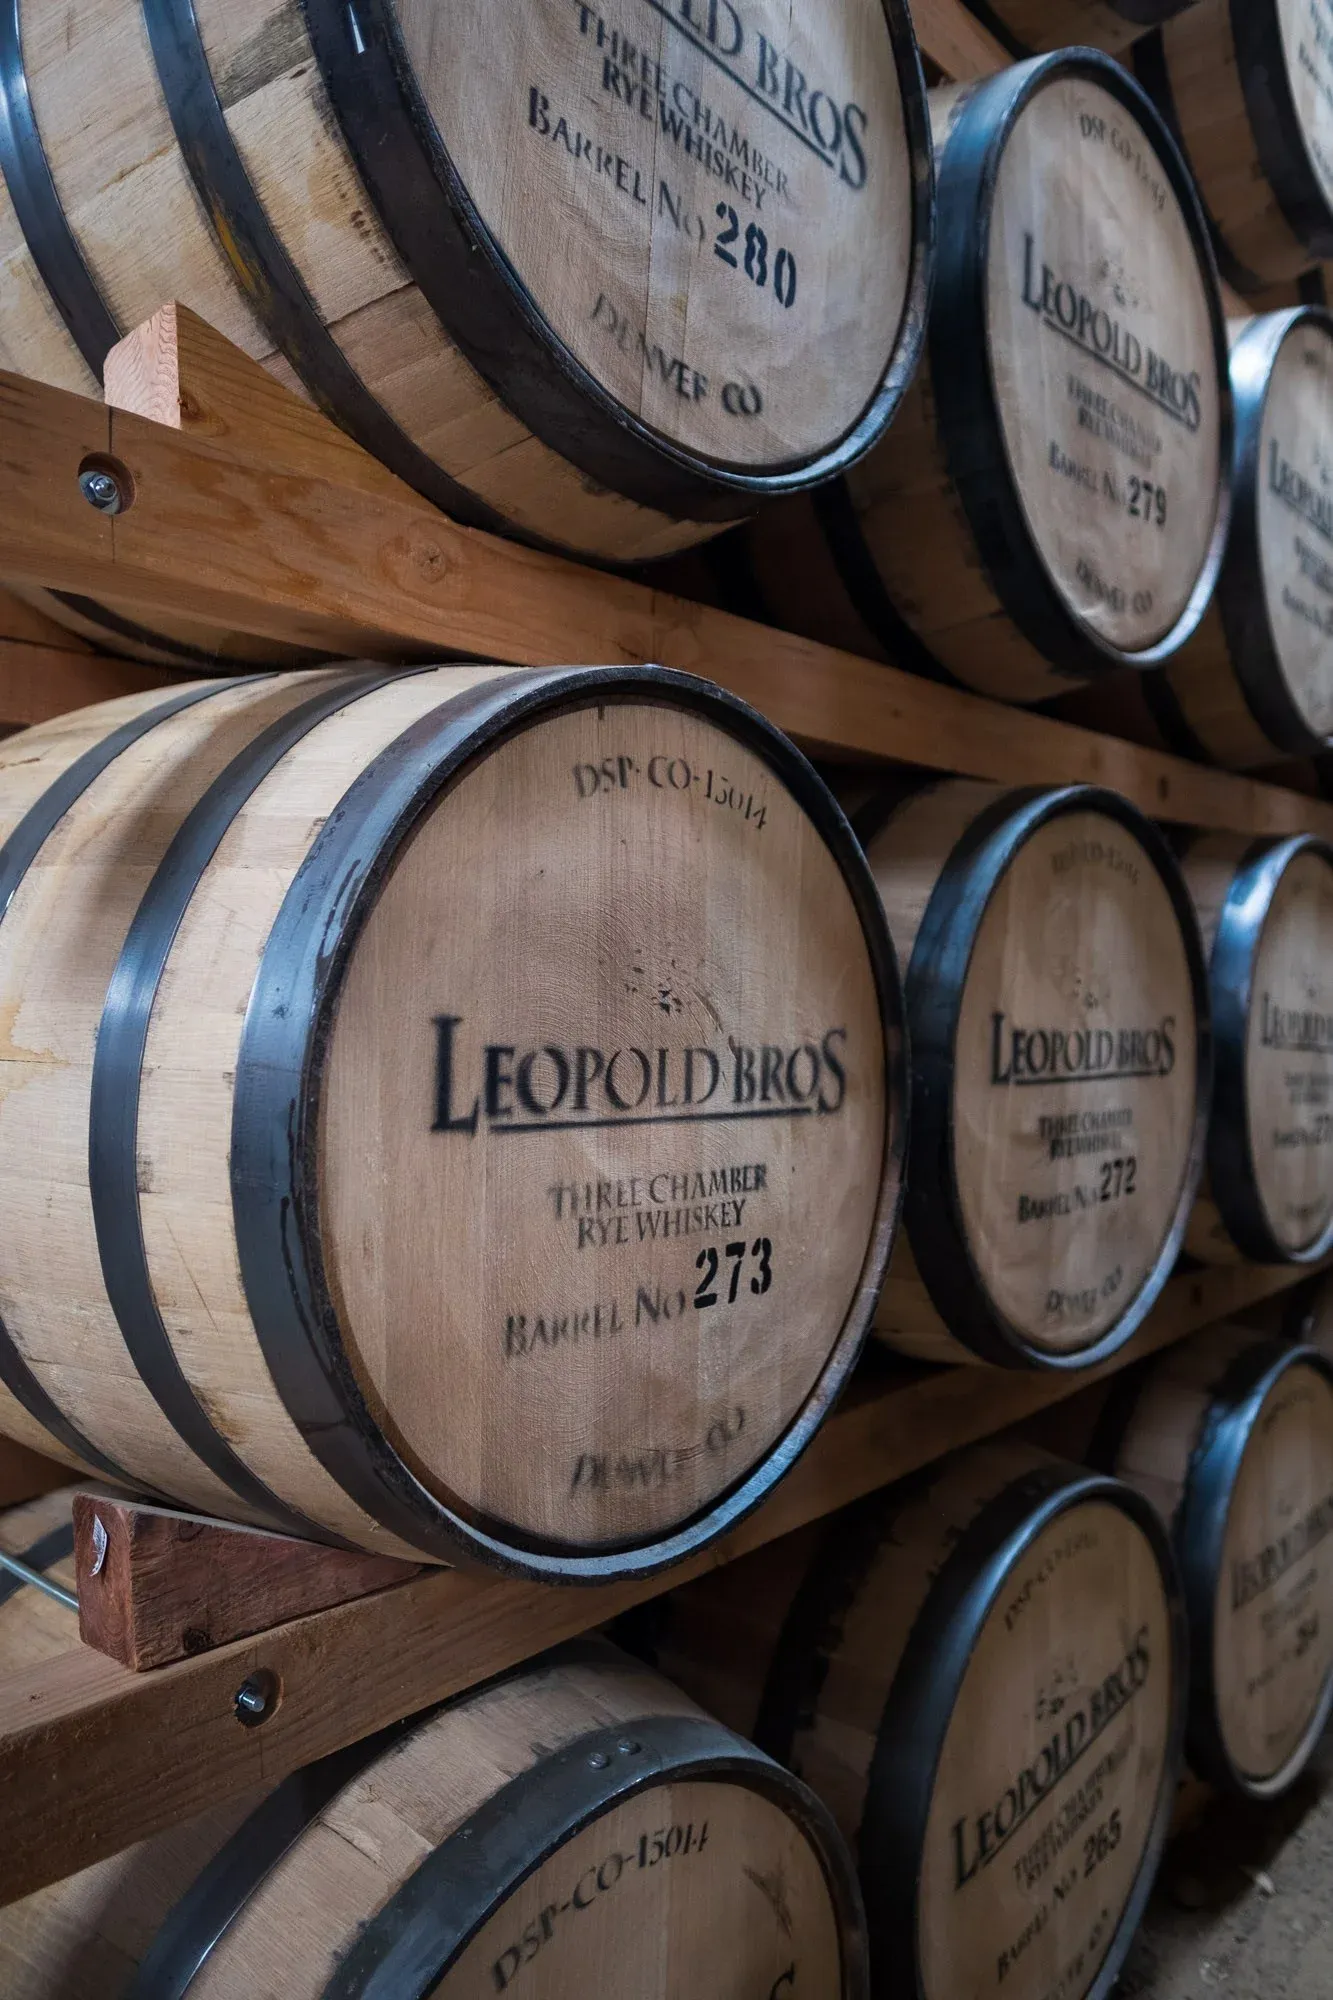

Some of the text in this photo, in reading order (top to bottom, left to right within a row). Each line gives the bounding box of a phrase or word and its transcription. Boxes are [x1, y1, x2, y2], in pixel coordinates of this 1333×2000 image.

[529, 86, 647, 204] BARREL
[577, 4, 790, 200] THREE CHAMBER
[602, 56, 766, 211] RYE WHISKEY
[755, 30, 868, 190] BROS
[713, 201, 797, 309] 280
[1021, 232, 1142, 376] LEOPOLD
[1146, 346, 1202, 432] BROS
[719, 380, 764, 416] CO
[1128, 474, 1167, 527] 279
[430, 1015, 848, 1136] LEOPOLD BROS
[991, 1012, 1176, 1084] LEOPOLD BROS
[548, 1162, 769, 1222] THREE CHAMBER
[577, 1199, 748, 1249] RYE WHISKEY
[1099, 1156, 1137, 1201] 272
[694, 1237, 773, 1309] 273
[953, 1712, 1087, 1893] LEOPOLD
[490, 1821, 710, 1992] DSP-CO-15014
